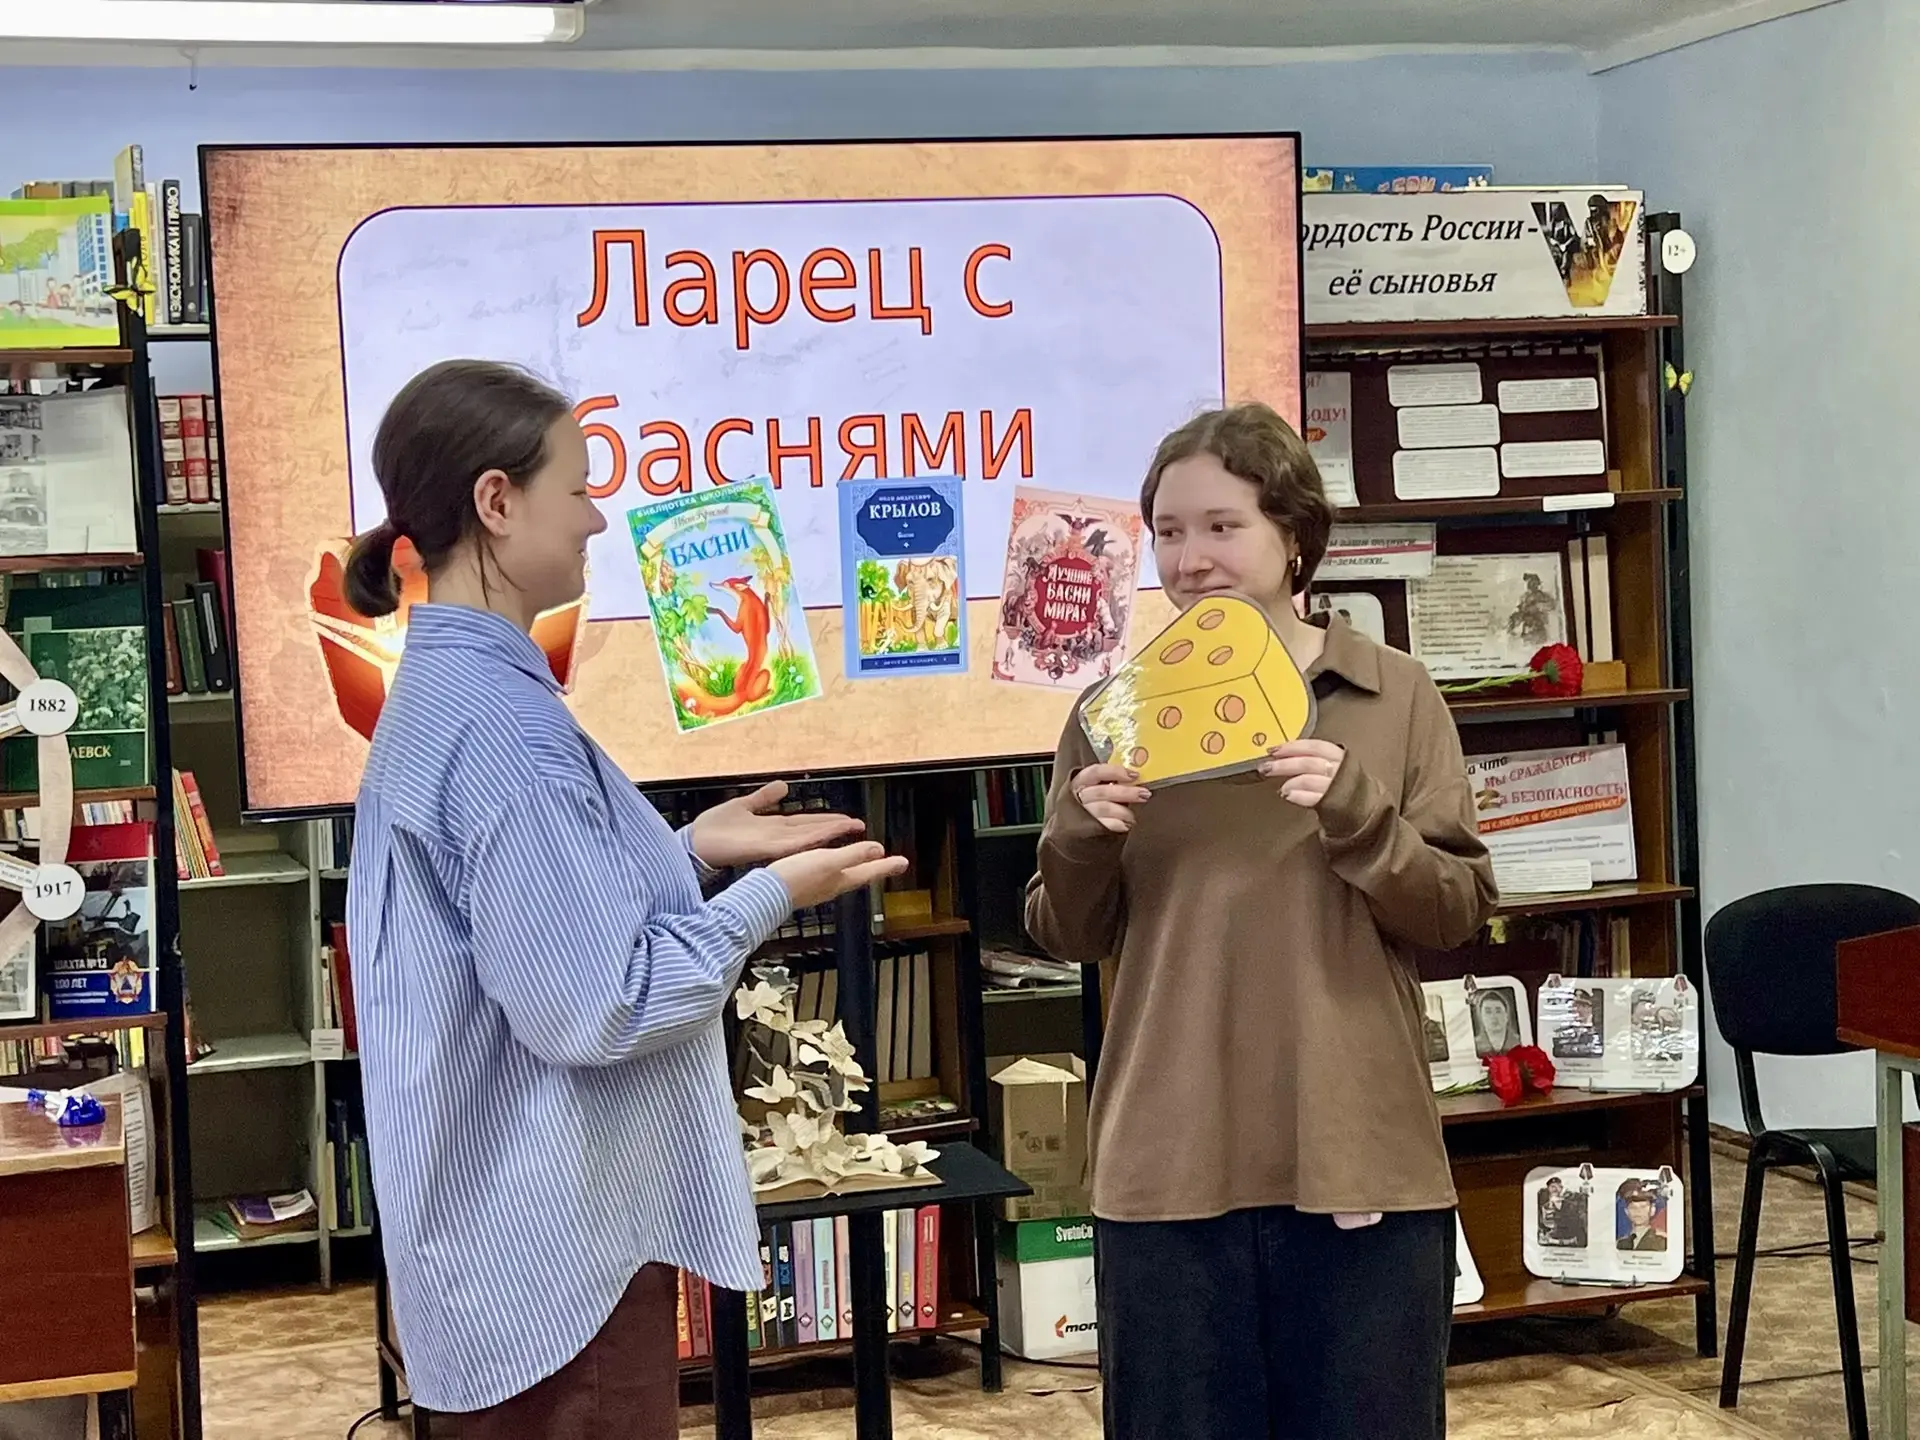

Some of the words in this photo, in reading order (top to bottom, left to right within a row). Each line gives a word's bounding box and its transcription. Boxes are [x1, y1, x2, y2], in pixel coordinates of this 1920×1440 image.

[1302, 221, 1414, 251] ордость
[1667, 244, 1687, 257] 12+
[577, 228, 932, 350] Ларец
[963, 243, 1014, 318] с
[1328, 269, 1363, 296] её
[1369, 273, 1498, 295] сыновья
[572, 393, 1035, 498] баснями
[869, 502, 942, 519] КРЫЛОВ
[670, 526, 750, 568] БАСНИ
[1042, 564, 1093, 585] ЛУЧШИЕ
[1046, 582, 1092, 604] БАСНИ
[1043, 601, 1080, 622] МИРА
[29, 698, 66, 712] 1882
[70, 745, 112, 759] ЛЕВСК
[1479, 755, 1509, 772] что
[1511, 782, 1628, 804] БЕЗОПАСНОСТЬ!
[35, 881, 72, 898] 1917
[1065, 1321, 1098, 1333] mon
